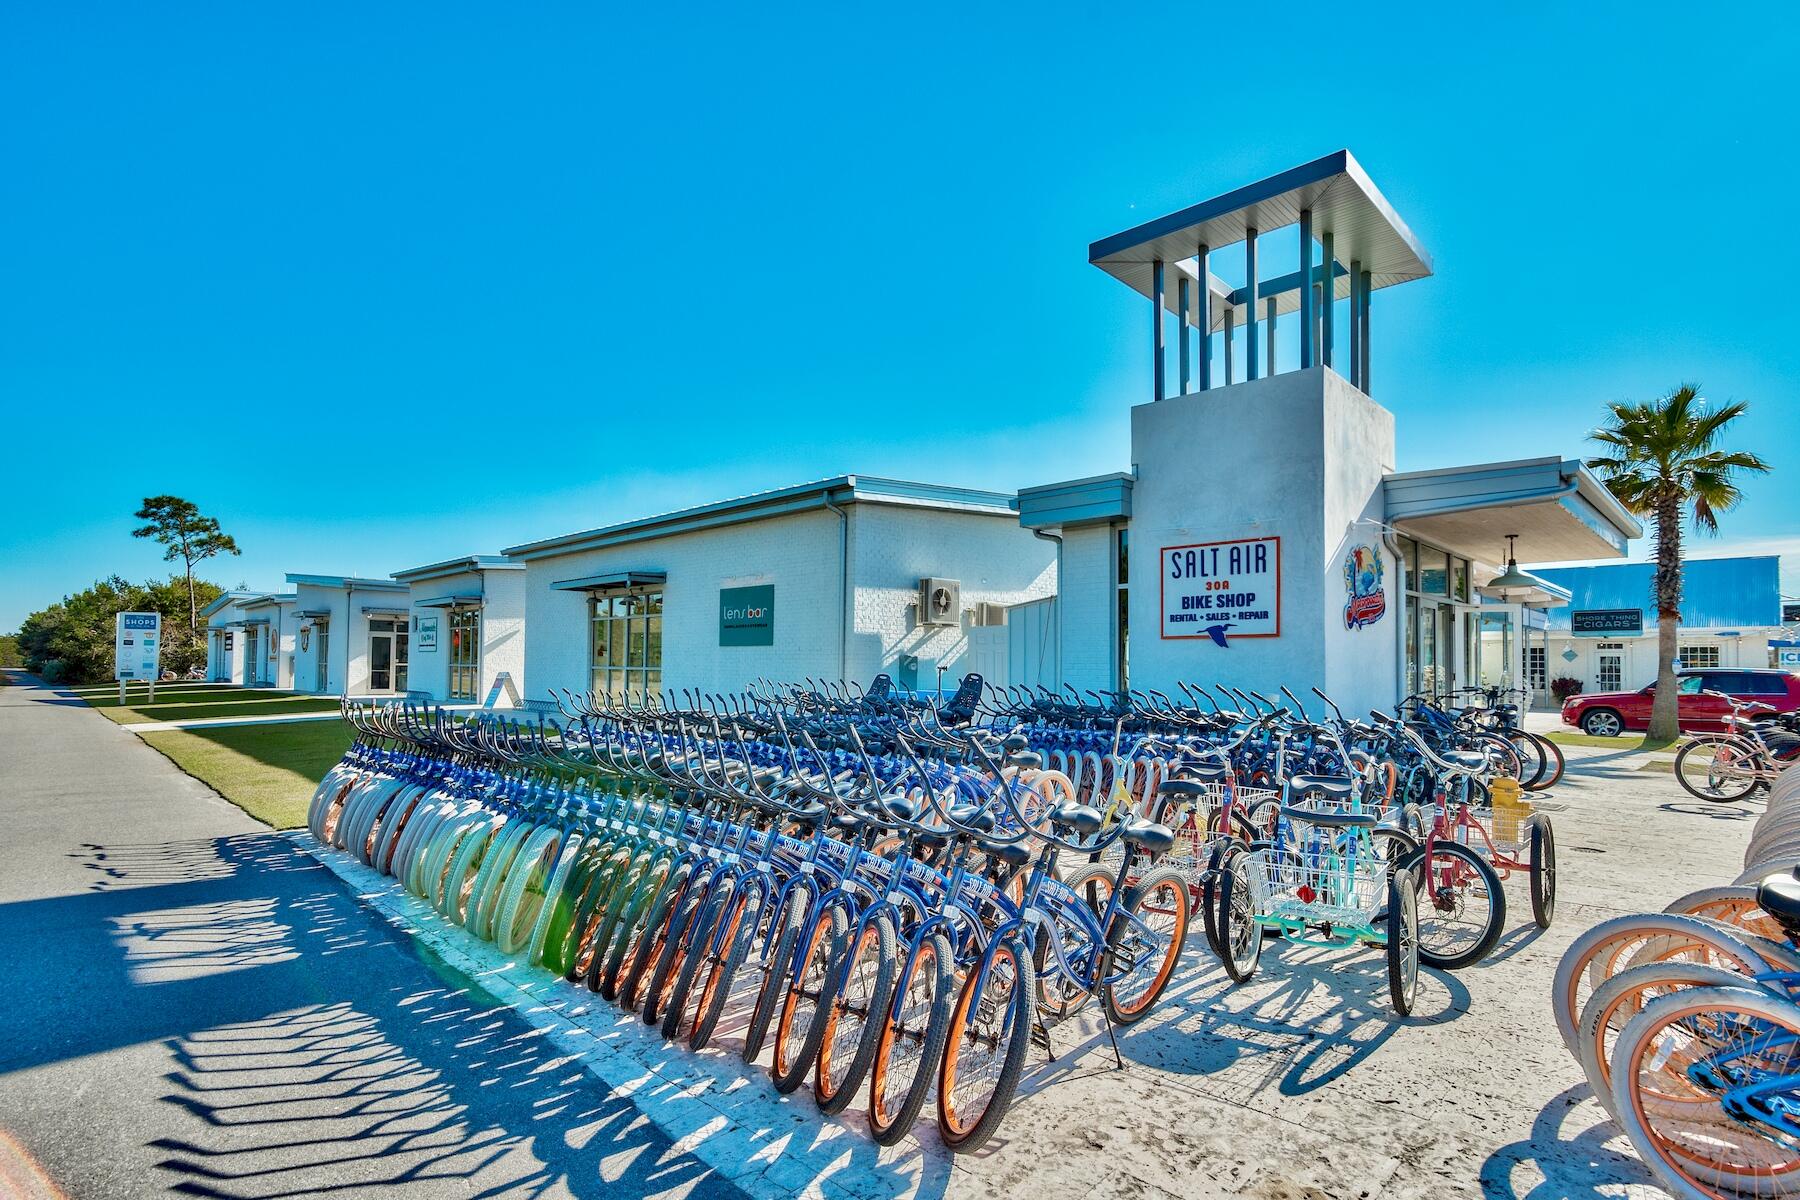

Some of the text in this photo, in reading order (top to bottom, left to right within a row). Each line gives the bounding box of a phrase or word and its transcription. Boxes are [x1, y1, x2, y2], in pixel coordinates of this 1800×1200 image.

[1171, 544, 1267, 579] SALT AIR
[1205, 580, 1230, 591] 30A
[1181, 592, 1256, 610] BIKE SHOP
[723, 604, 768, 620] lens bar
[1169, 610, 1269, 623] RENTAL SALES REPAIR
[1583, 620, 1630, 628] CIGARS
[1781, 652, 1800, 662] IC
[909, 863, 926, 878] SALT
[966, 877, 982, 893] SALT
[1044, 880, 1061, 896] SALT
